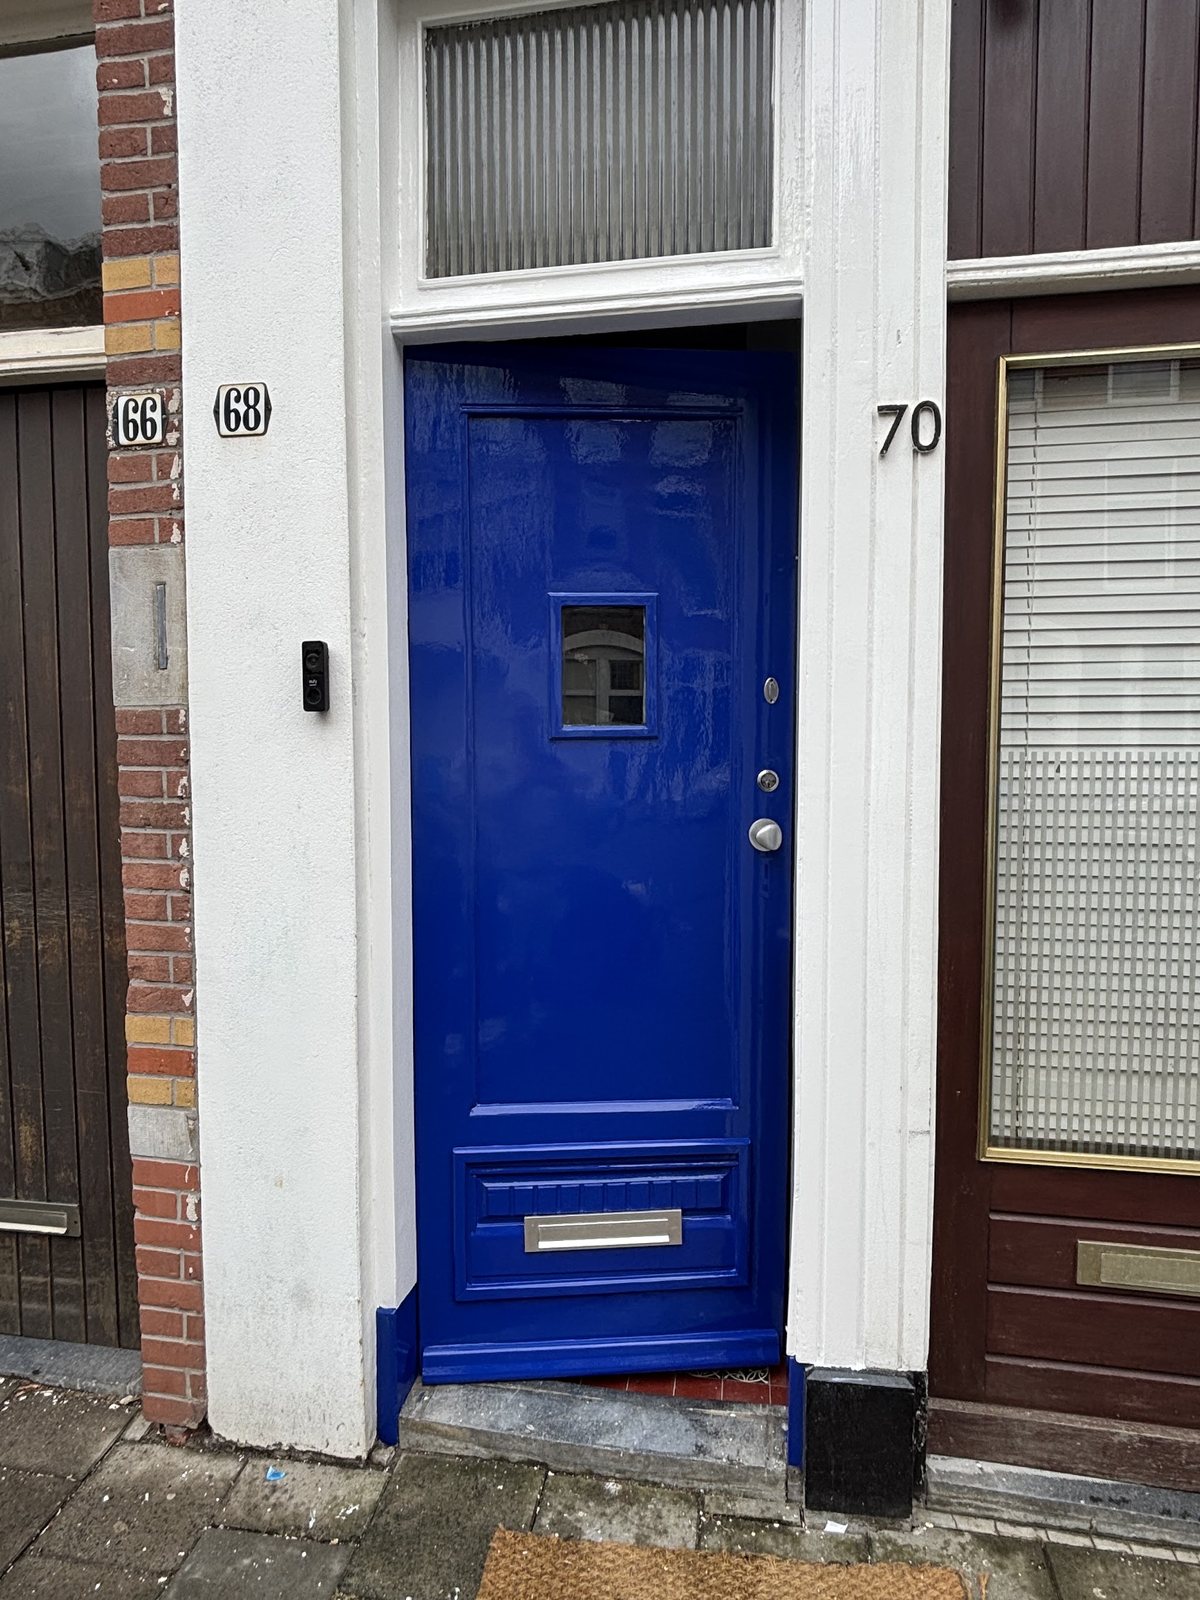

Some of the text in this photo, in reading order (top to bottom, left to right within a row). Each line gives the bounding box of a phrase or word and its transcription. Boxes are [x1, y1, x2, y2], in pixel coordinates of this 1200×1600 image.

[122, 397, 157, 441] 66
[224, 386, 261, 432] 68
[877, 400, 941, 455] 70
